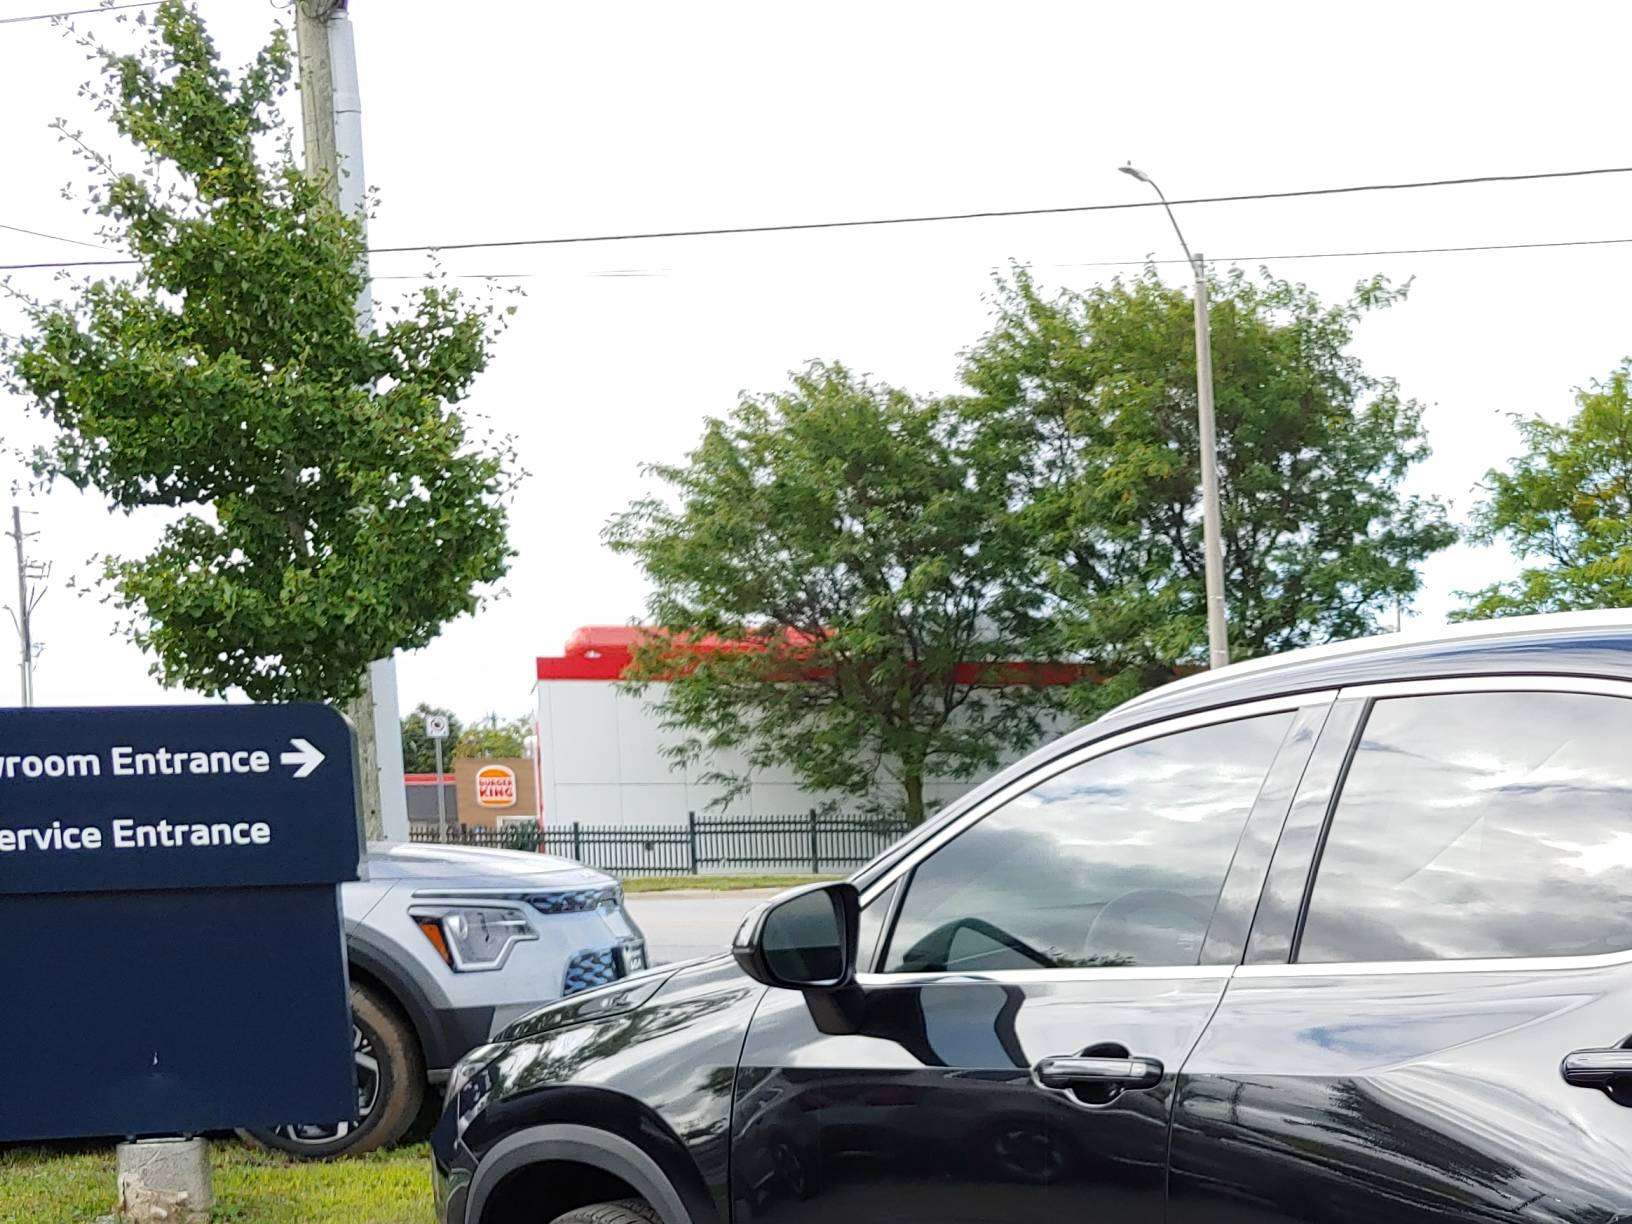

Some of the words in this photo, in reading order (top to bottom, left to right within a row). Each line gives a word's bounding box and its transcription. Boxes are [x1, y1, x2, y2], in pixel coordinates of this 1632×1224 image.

[0, 753, 101, 778] room
[111, 746, 270, 776] Entrance
[479, 787, 513, 797] KING
[112, 818, 271, 848] Entrance
